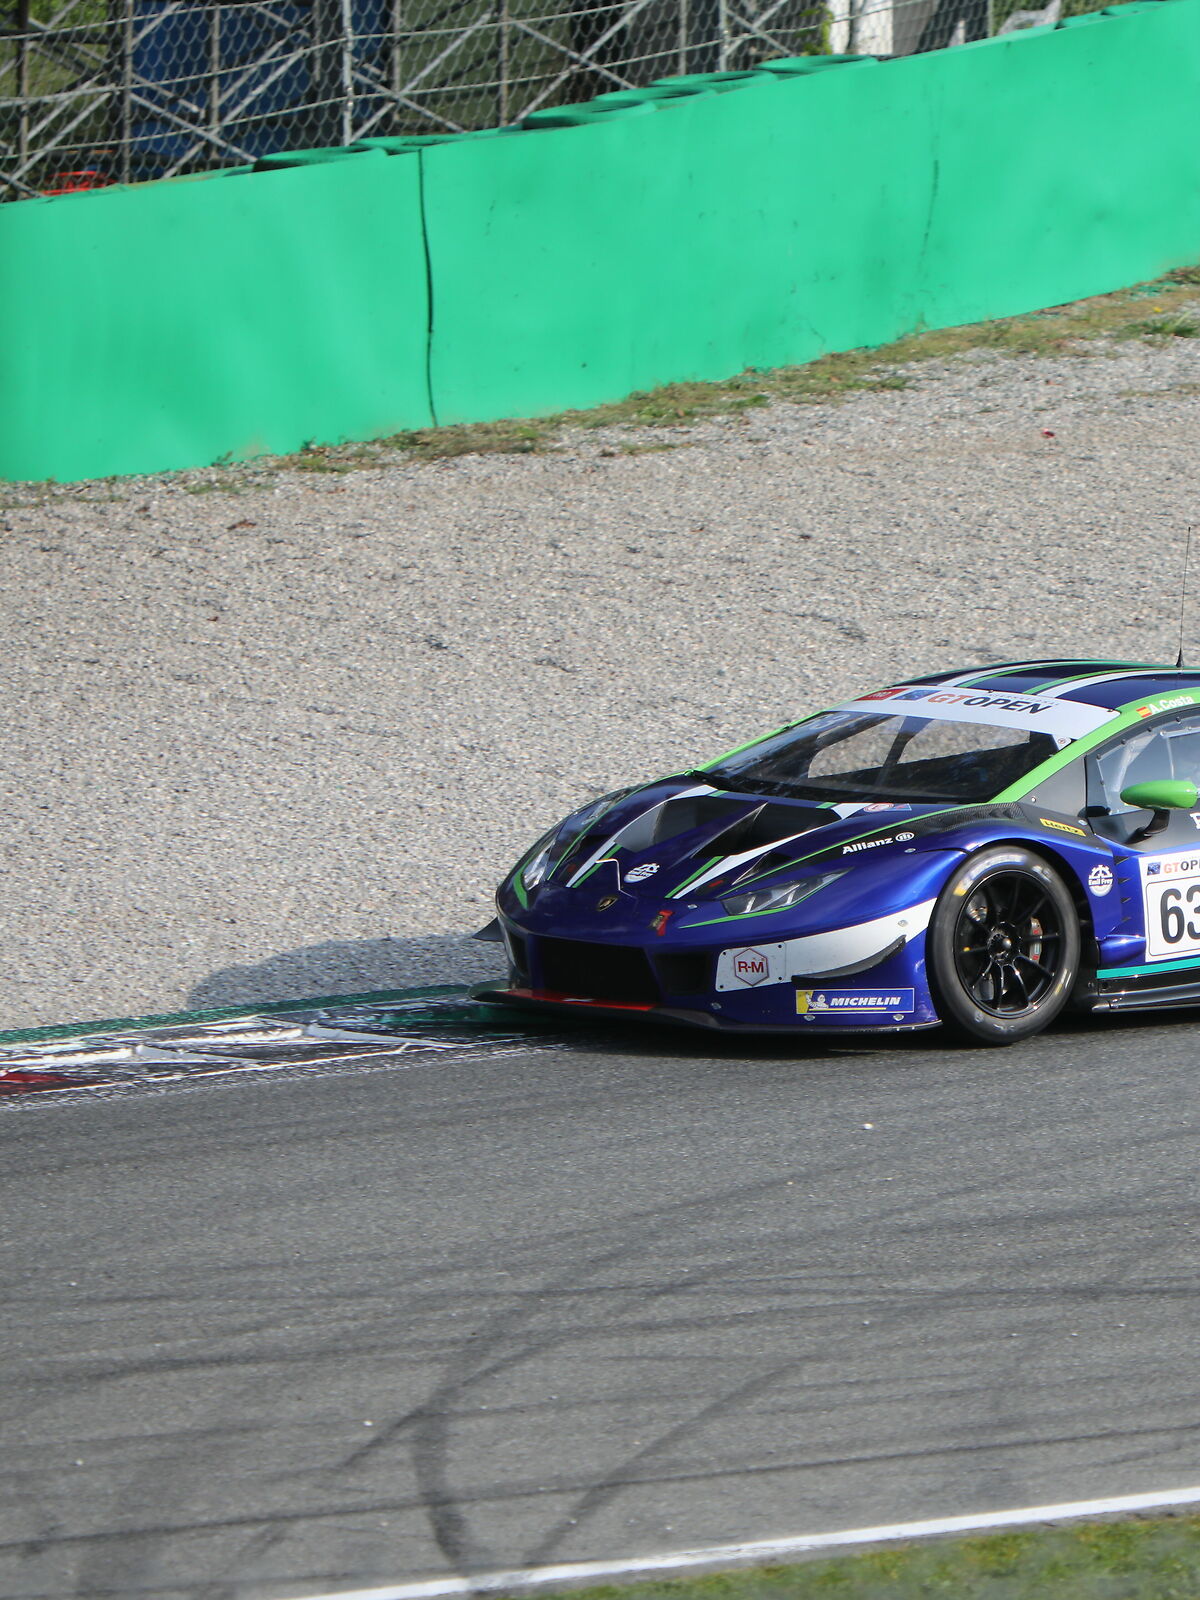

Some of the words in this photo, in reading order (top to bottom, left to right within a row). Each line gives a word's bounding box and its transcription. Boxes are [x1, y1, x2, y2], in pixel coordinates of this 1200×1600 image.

[1149, 695, 1195, 715] A.Costa
[842, 837, 894, 854] Allianz
[737, 961, 764, 974] R-M
[829, 996, 902, 1007] MICHELIN
